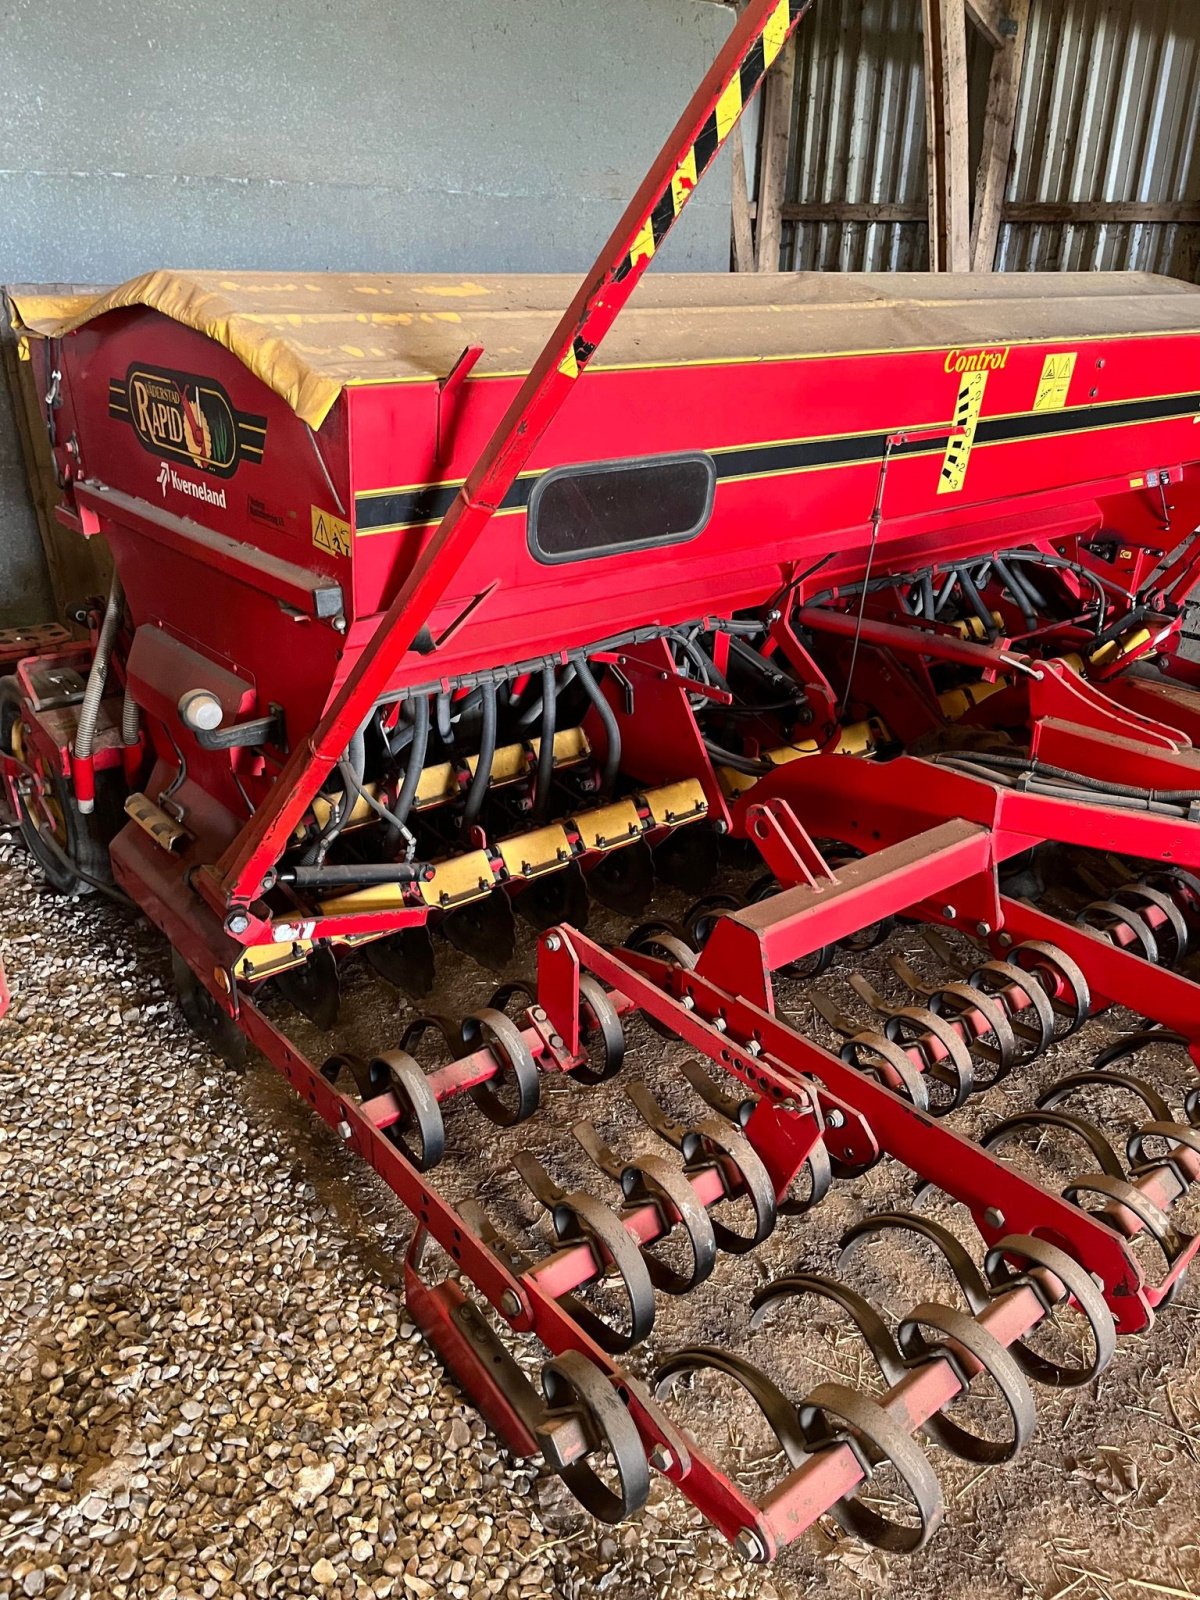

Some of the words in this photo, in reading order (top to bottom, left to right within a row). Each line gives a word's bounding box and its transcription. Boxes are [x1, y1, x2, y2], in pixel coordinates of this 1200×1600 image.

[944, 346, 1010, 373] Control
[133, 380, 183, 442] RAPID
[170, 469, 227, 509] Kverneland
